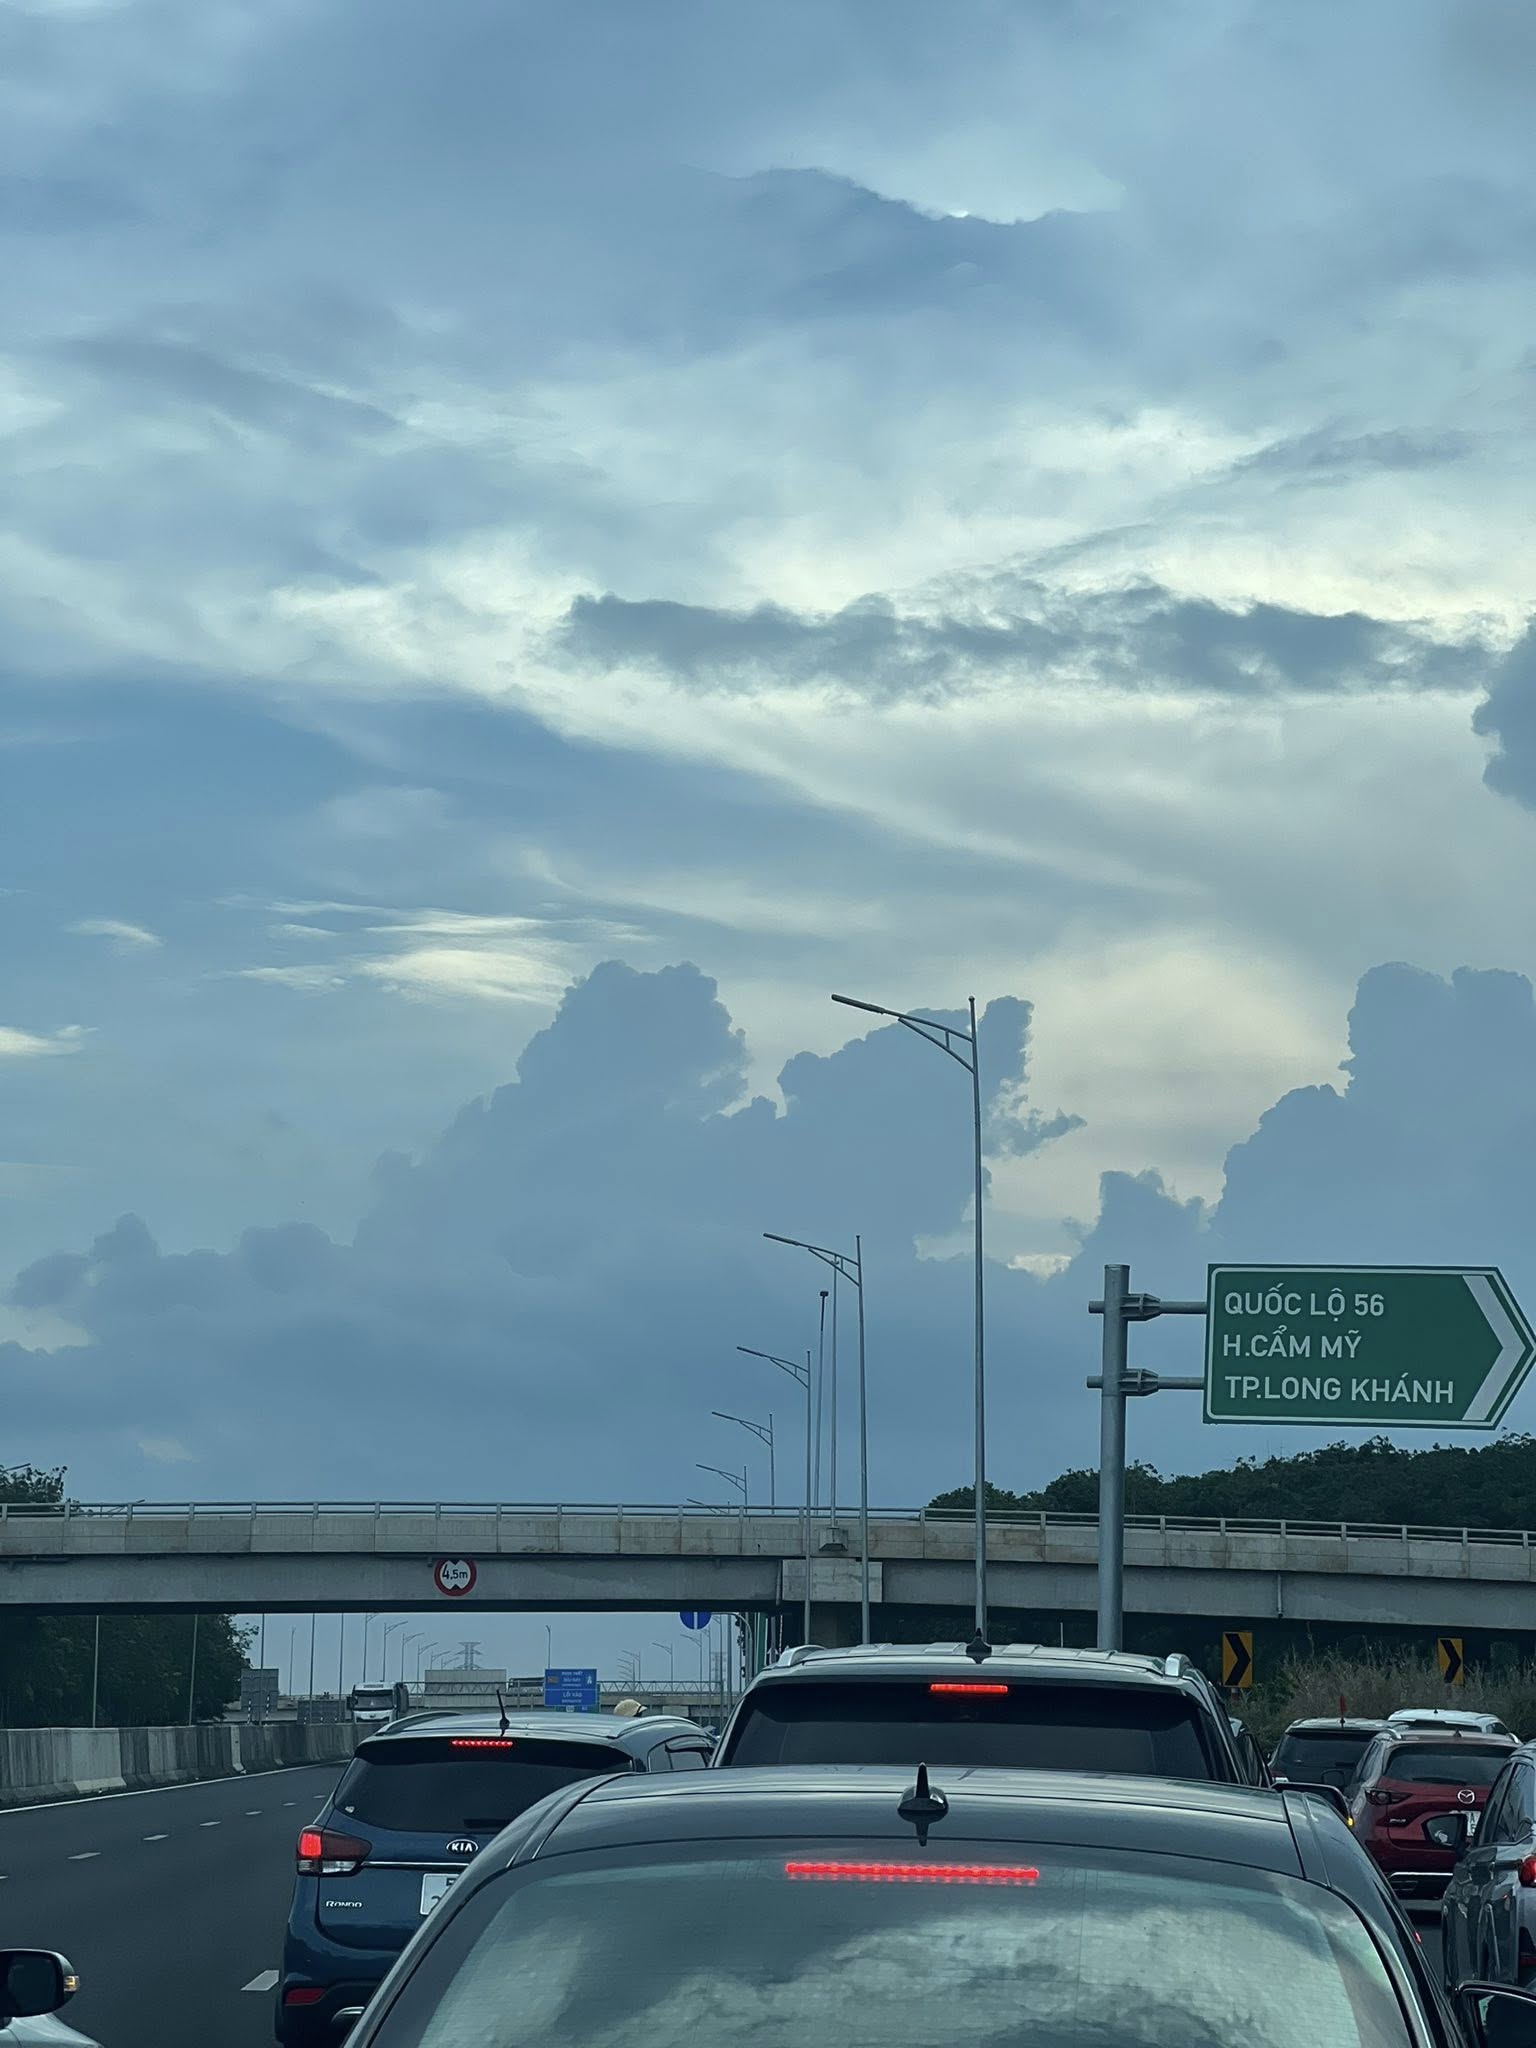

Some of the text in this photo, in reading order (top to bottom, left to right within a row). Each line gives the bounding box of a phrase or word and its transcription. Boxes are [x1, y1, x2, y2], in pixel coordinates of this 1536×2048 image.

[1224, 1283, 1385, 1322] QUỐC LỘ 56
[1223, 1325, 1362, 1358] H.CẨM MỸ
[1225, 1372, 1454, 1404] TP.LONG KHÁNH
[451, 1842, 473, 1852] KIA
